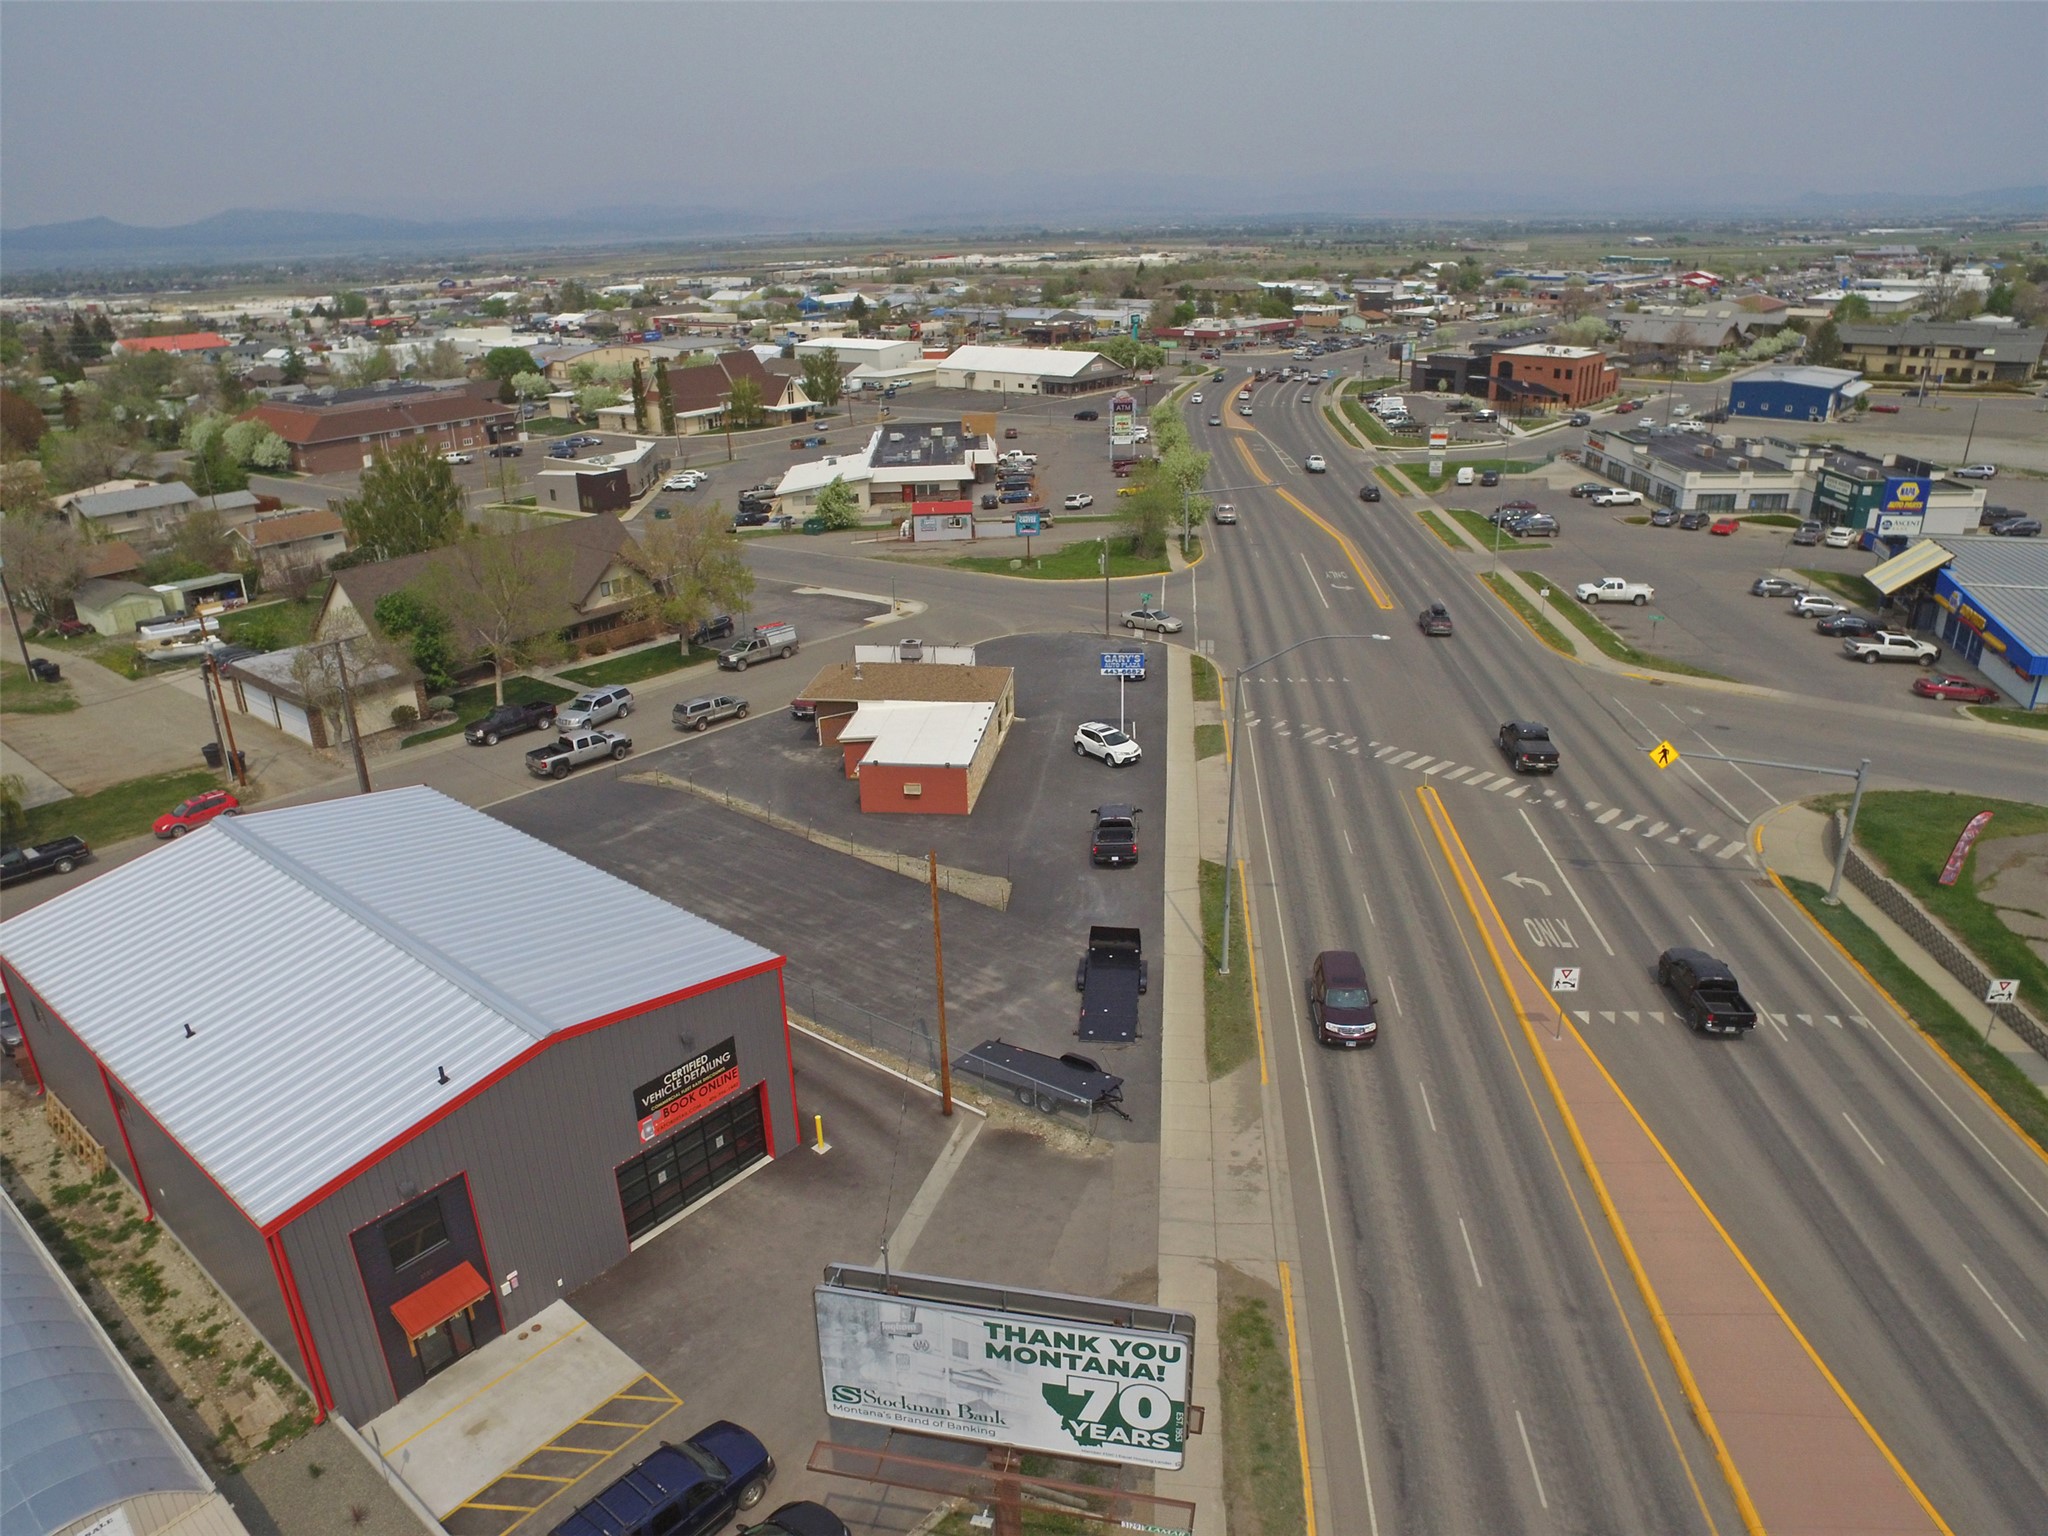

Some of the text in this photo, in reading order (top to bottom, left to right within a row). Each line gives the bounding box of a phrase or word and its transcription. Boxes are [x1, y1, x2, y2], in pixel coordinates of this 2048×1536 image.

[1887, 501, 1924, 509] AUTO PARTS
[1901, 487, 1916, 497] NAPA
[1104, 654, 1141, 663] GARY'S
[1523, 918, 1579, 948] ONLY
[642, 1080, 682, 1107] VEHICLE
[684, 1051, 731, 1085] DETAILING
[664, 1054, 708, 1085] CERTIFIED
[651, 1092, 681, 1111] COMMERCIAL
[663, 1092, 697, 1118] BOOK
[699, 1069, 738, 1097] ONLINE
[984, 1321, 1181, 1363] THANK YOU
[985, 1342, 1166, 1382] MONTANA!
[863, 1389, 951, 1416] Stockman
[957, 1403, 1006, 1425] Bank
[1067, 1375, 1171, 1431] 70
[1176, 1411, 1184, 1426] EST.
[833, 1403, 996, 1437] Montana's Brand of Banking
[1068, 1420, 1170, 1449] YEARS
